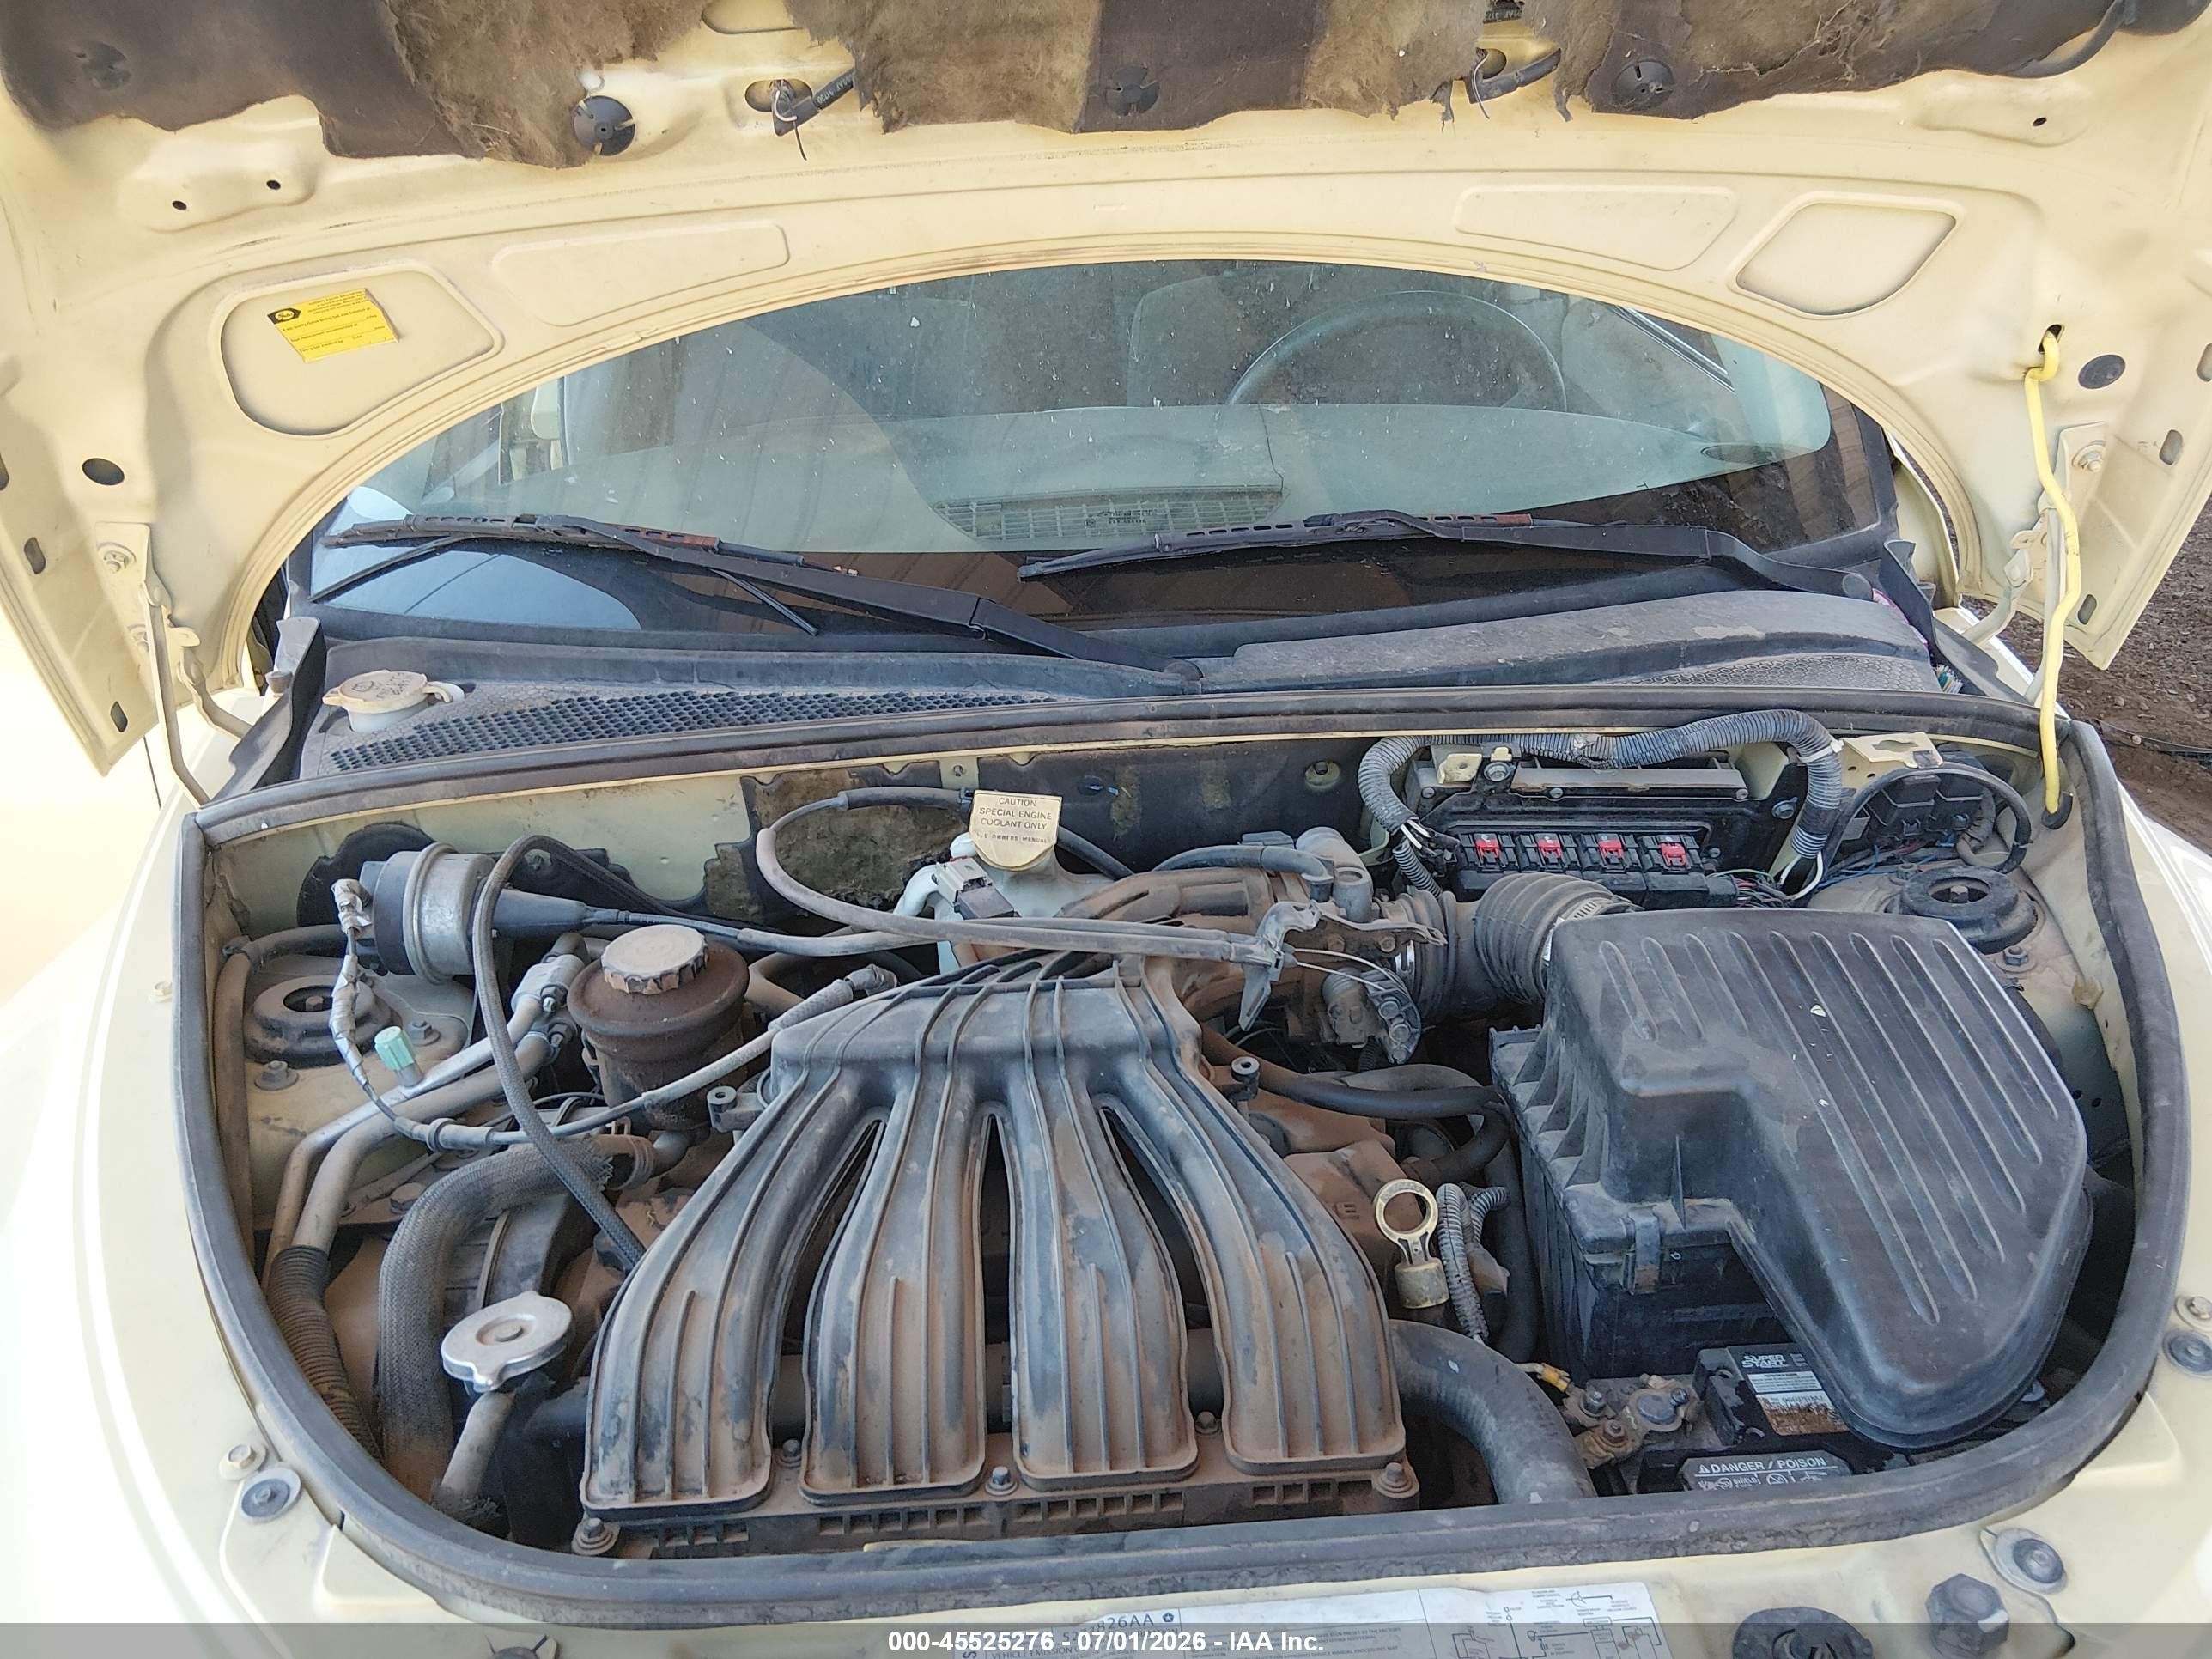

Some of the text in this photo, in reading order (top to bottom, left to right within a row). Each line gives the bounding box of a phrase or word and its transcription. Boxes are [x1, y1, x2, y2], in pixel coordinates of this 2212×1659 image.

[999, 797, 1037, 807] CAUTION
[979, 807, 1053, 820] SPECIAL ENGINE
[981, 817, 1048, 830] COOLANT ONLY
[1743, 1353, 1786, 1363] SUPER
[1741, 1360, 1785, 1369] START
[1710, 1460, 1766, 1474] DANGER
[1777, 1456, 1827, 1469] POISON
